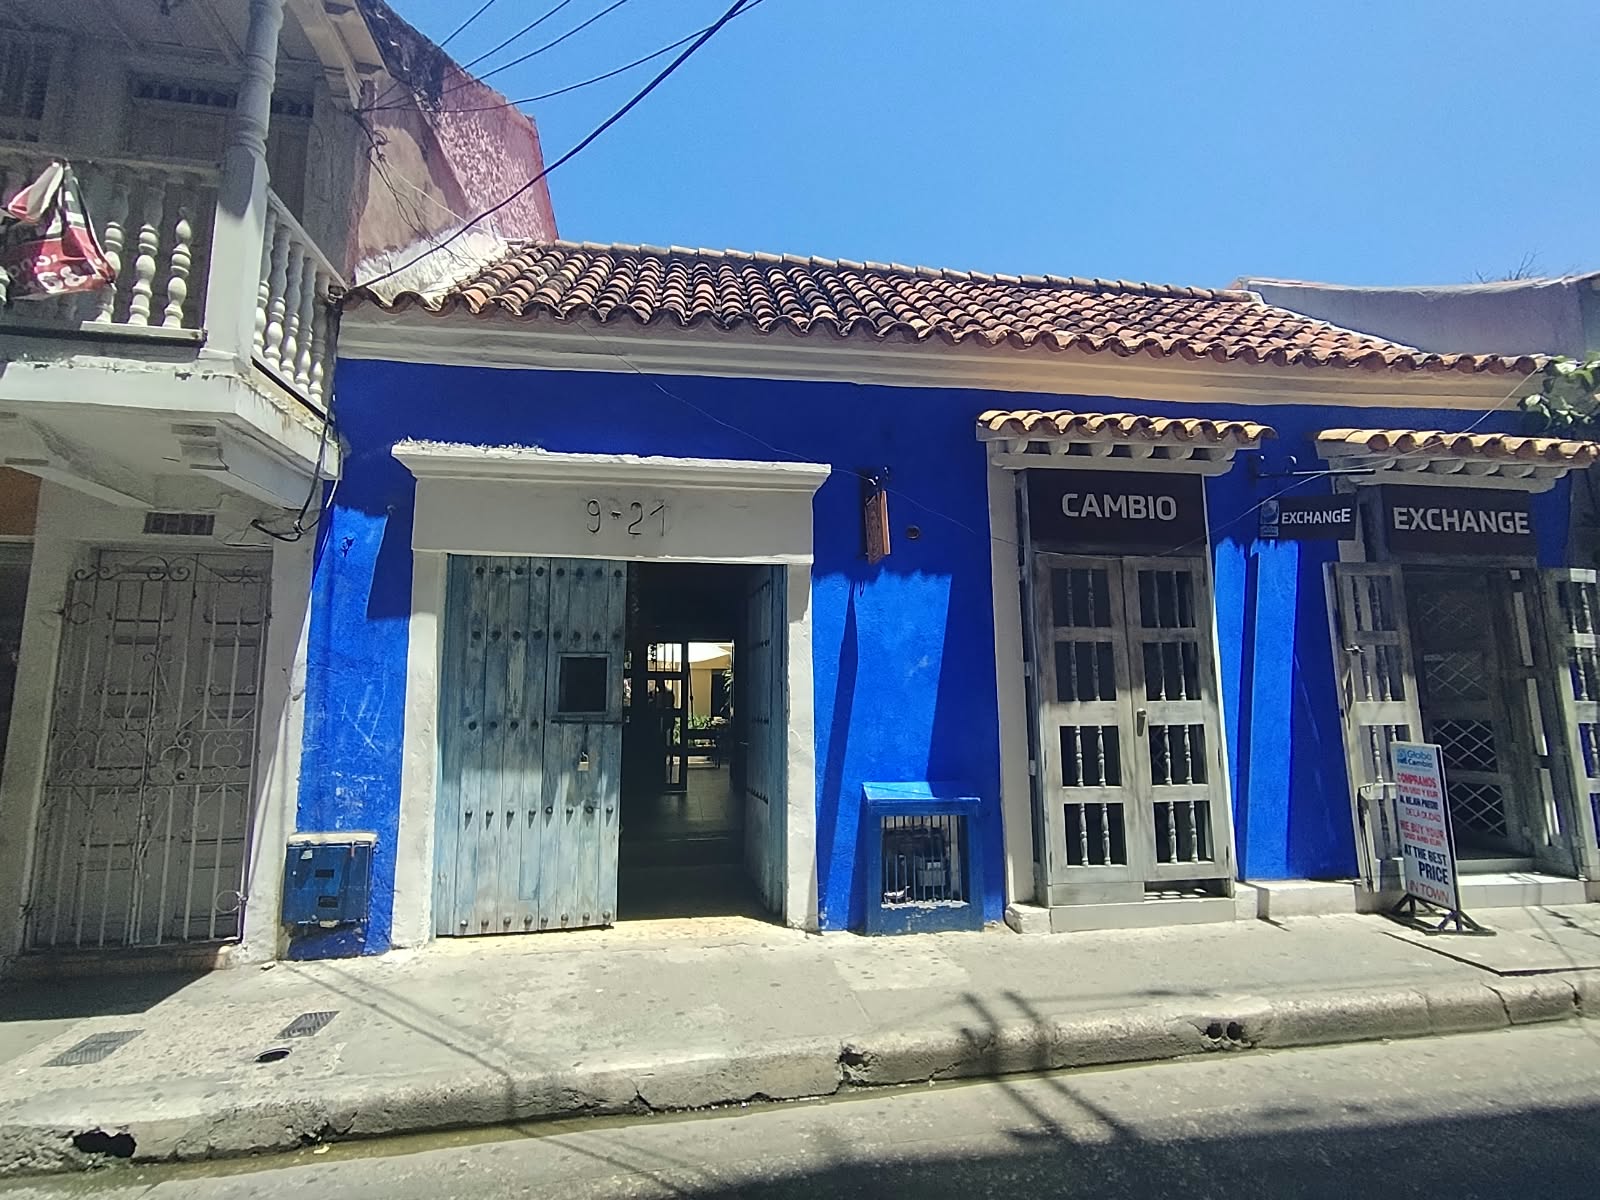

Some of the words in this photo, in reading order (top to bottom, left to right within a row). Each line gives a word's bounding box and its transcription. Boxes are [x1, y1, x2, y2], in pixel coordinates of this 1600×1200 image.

[586, 498, 665, 537] 9-21
[1060, 492, 1179, 522] CAMBIO
[1281, 508, 1352, 525] EXCHANGE
[1392, 506, 1531, 536] EXCHANGE
[1411, 823, 1423, 835] BUY
[1405, 844, 1412, 856] AT
[1413, 846, 1427, 860] THE
[1428, 851, 1447, 866] BEST
[1419, 861, 1449, 884] PRICE
[1410, 880, 1419, 893] IN
[1420, 883, 1449, 903] TOWN
